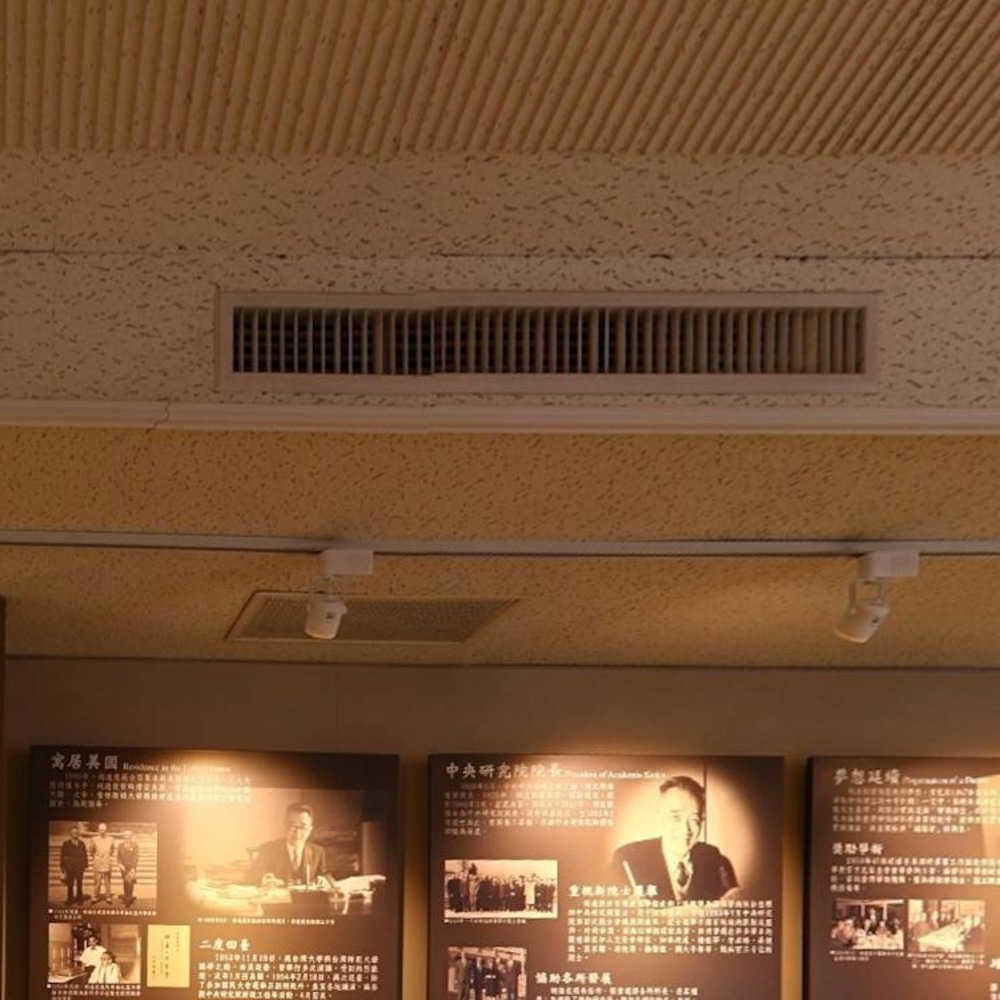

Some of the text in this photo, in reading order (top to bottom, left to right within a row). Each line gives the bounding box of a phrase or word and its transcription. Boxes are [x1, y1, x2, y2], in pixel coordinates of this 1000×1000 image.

[51, 752, 118, 770] 寓居美國
[445, 762, 565, 779] 中央研究院院長
